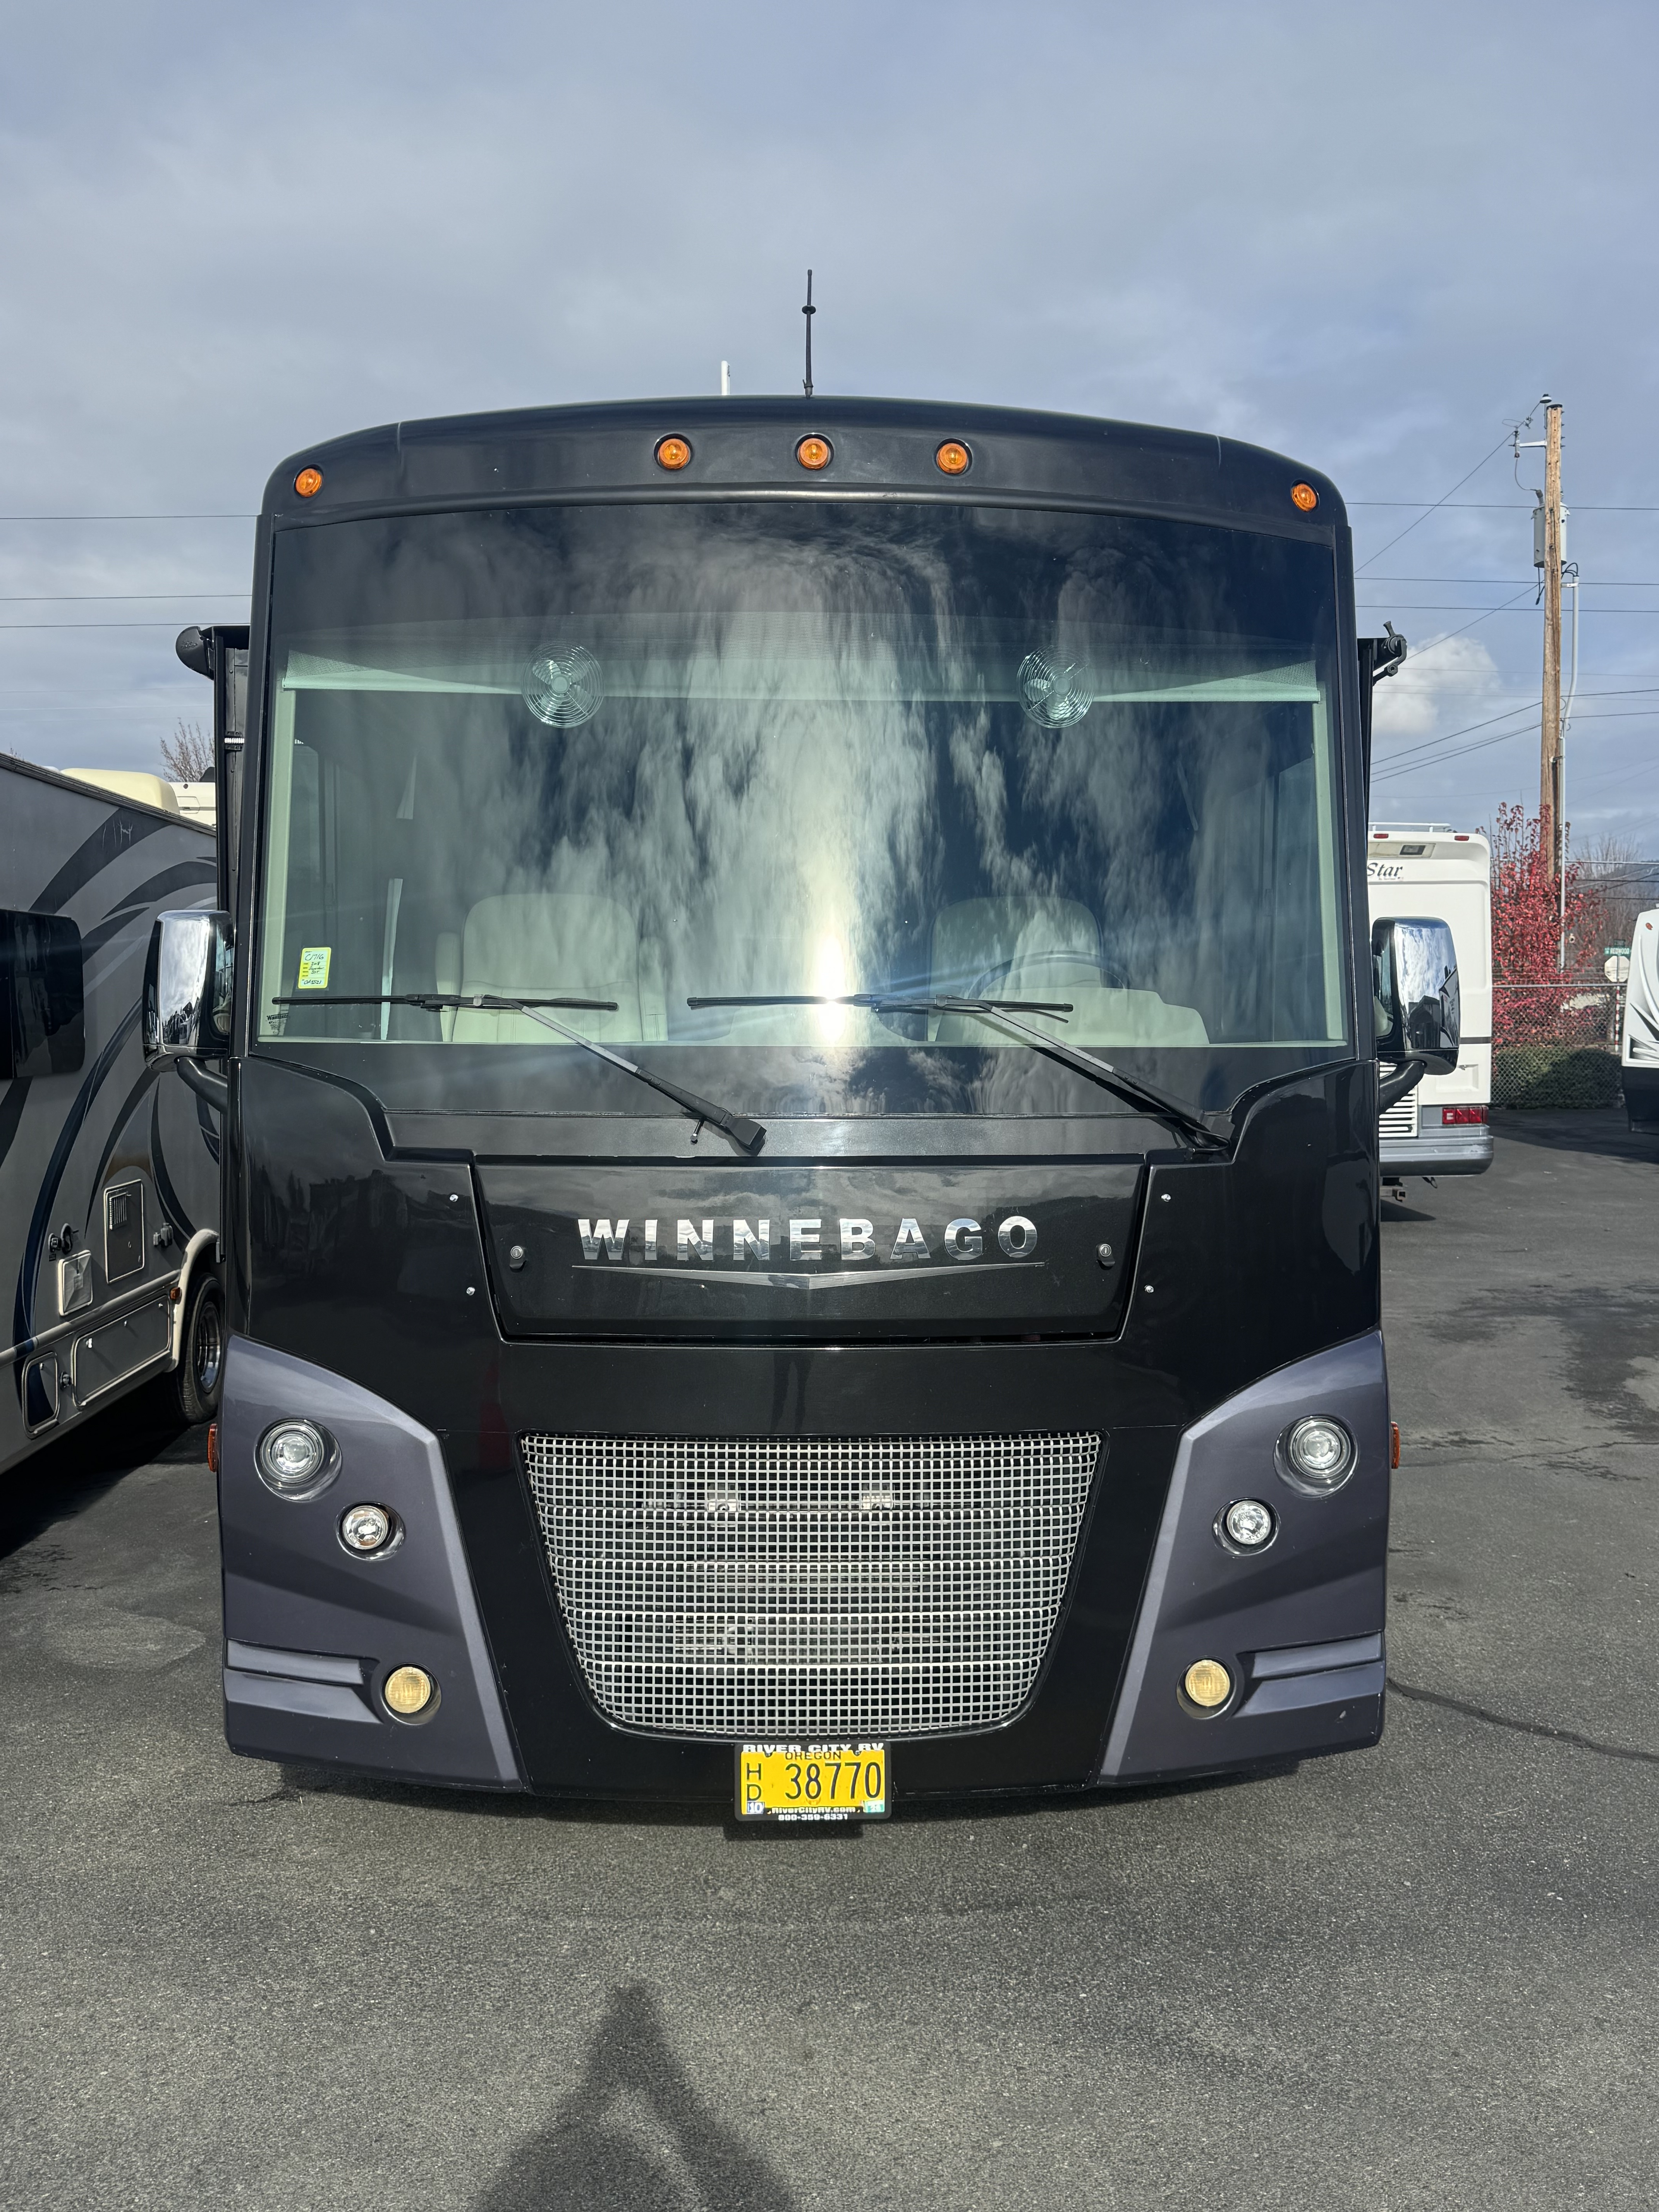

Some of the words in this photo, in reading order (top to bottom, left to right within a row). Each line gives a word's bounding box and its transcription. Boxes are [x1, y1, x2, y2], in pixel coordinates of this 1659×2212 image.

[1367, 862, 1403, 876] Star
[577, 1216, 1038, 1261] WINNEBAGO
[743, 1744, 801, 1753] RIVER
[808, 1744, 852, 1752] CITY
[858, 1743, 884, 1751] RV
[785, 1751, 842, 1760] OREGON
[785, 1761, 881, 1800] 38770
[749, 1802, 763, 1813] 10
